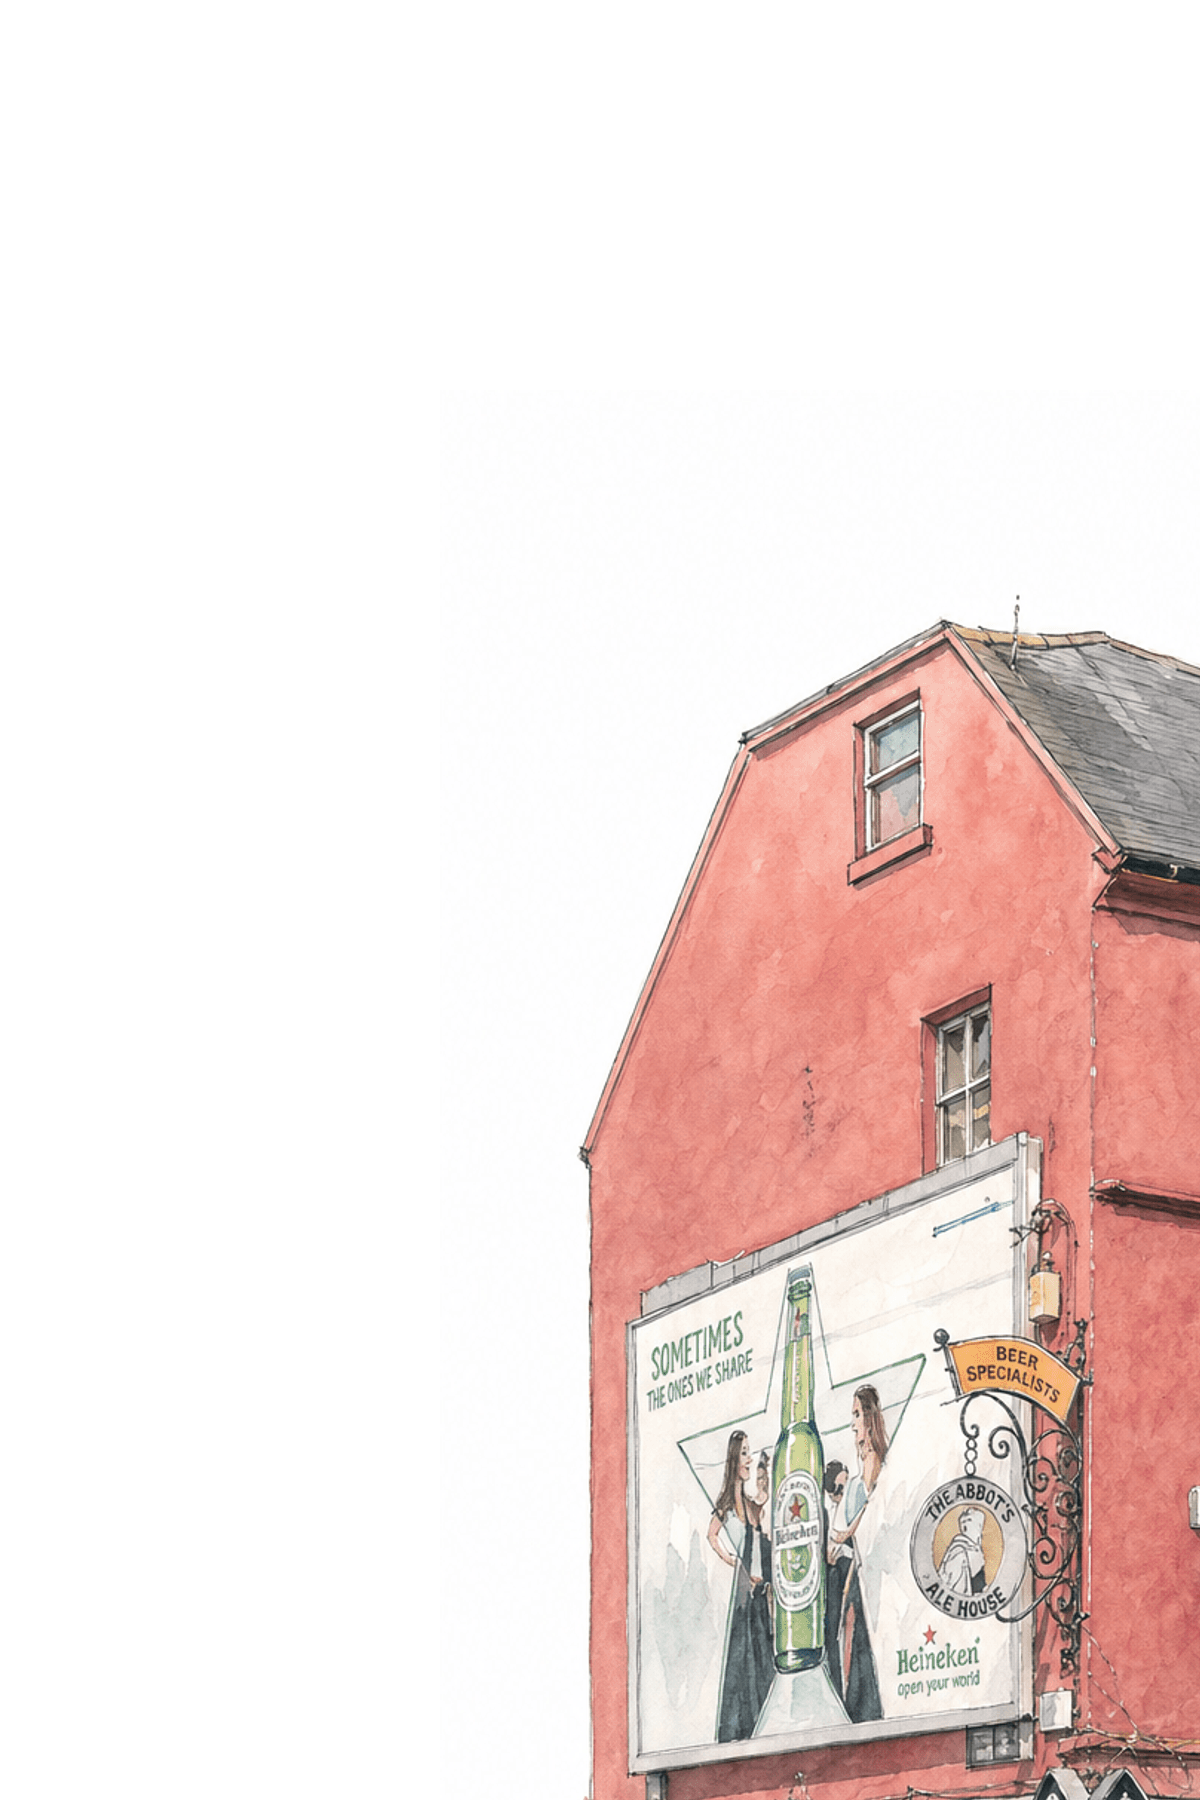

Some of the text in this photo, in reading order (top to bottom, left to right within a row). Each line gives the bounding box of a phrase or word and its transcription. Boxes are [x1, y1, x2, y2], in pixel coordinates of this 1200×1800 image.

[651, 1310, 744, 1381] SOMETIMES
[996, 1346, 1038, 1371] BEER
[646, 1348, 753, 1412] THE ONES WE SHARE
[966, 1365, 1061, 1403] SPECIALISTS
[925, 1483, 1015, 1523] THE ABBOT'S
[926, 1582, 1007, 1618] ALE HOUSE
[896, 1642, 980, 1676] Heineken
[897, 1669, 980, 1700] open your world
